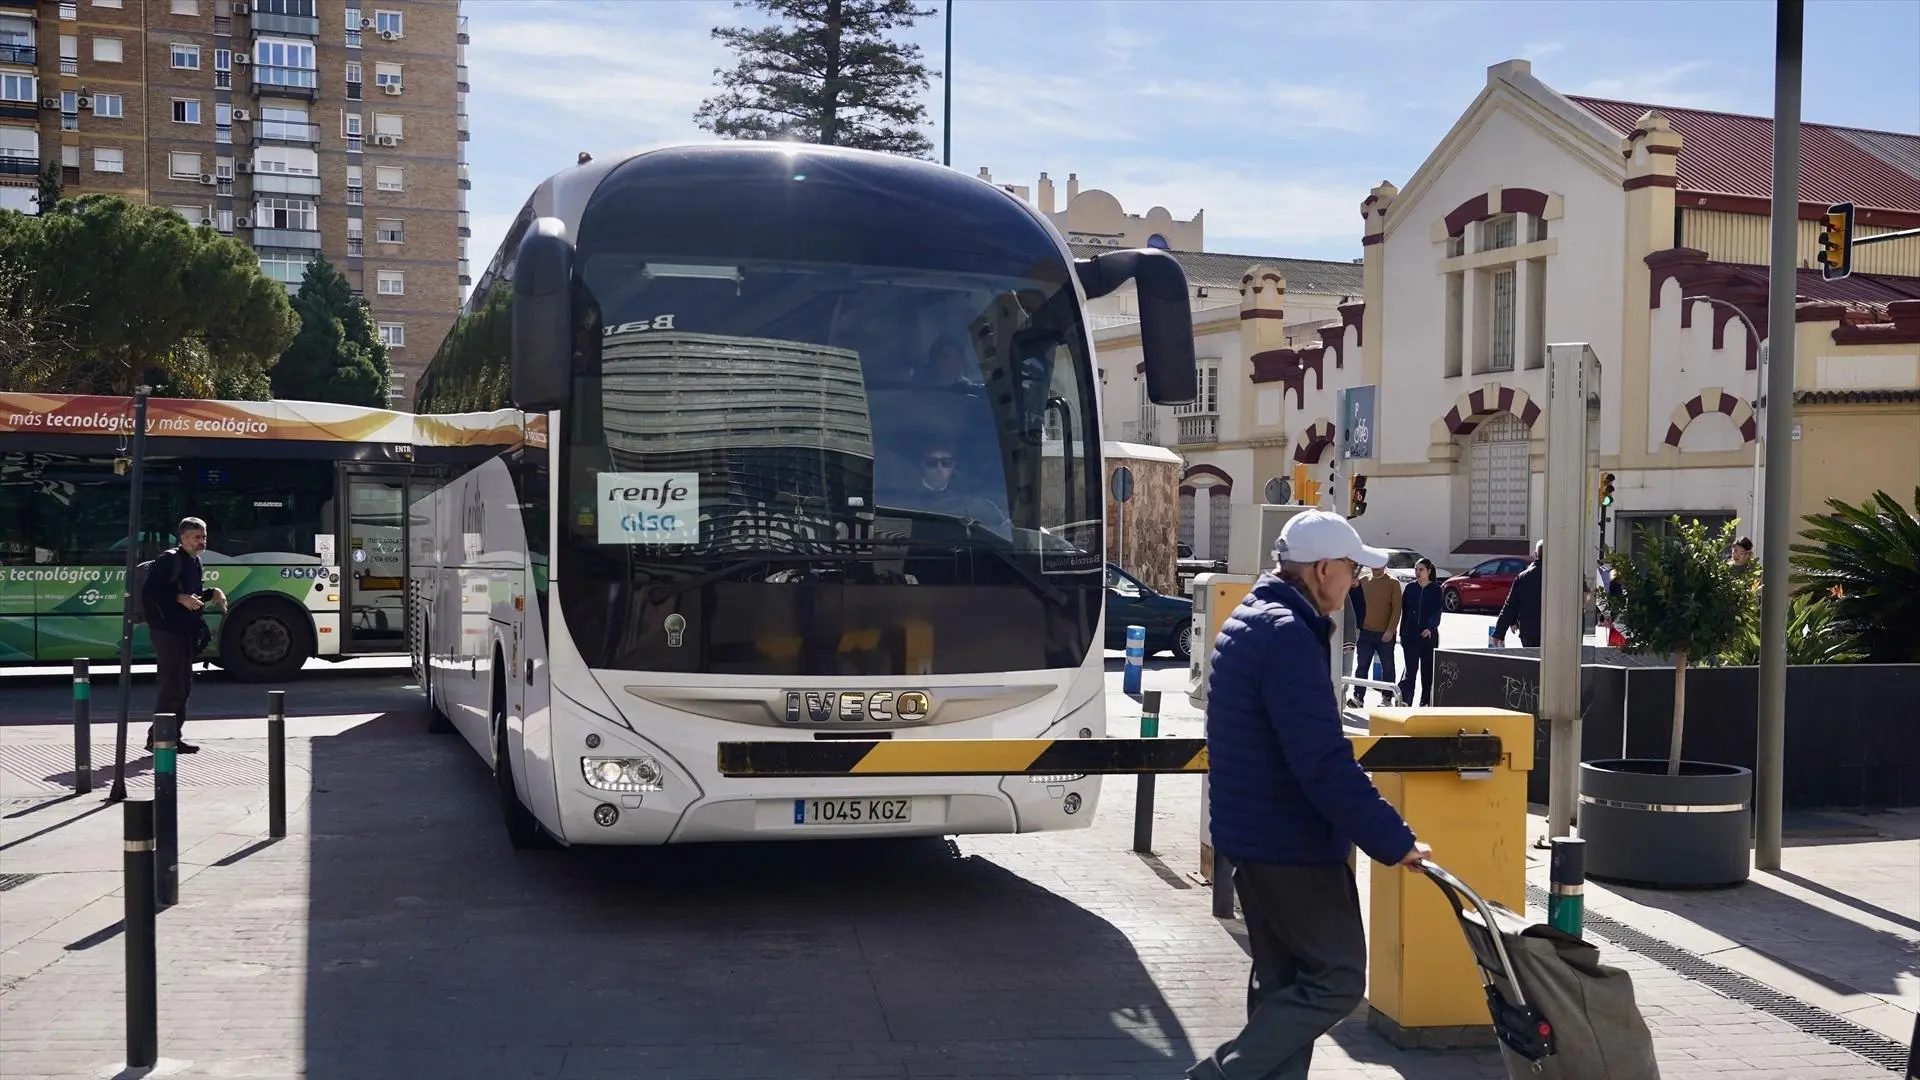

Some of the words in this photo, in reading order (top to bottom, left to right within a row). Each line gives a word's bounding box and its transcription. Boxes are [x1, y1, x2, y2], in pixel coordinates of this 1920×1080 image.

[9, 411, 42, 426] más
[144, 419, 156, 432] y
[159, 416, 191, 430] más
[194, 417, 268, 434] ecológico
[608, 479, 688, 509] renfe
[621, 512, 676, 531] alsa
[10, 566, 101, 584] tecnológico
[102, 570, 114, 584] y
[786, 692, 928, 721] IVECO
[812, 801, 862, 820] 1045
[868, 800, 908, 820] KGZ
